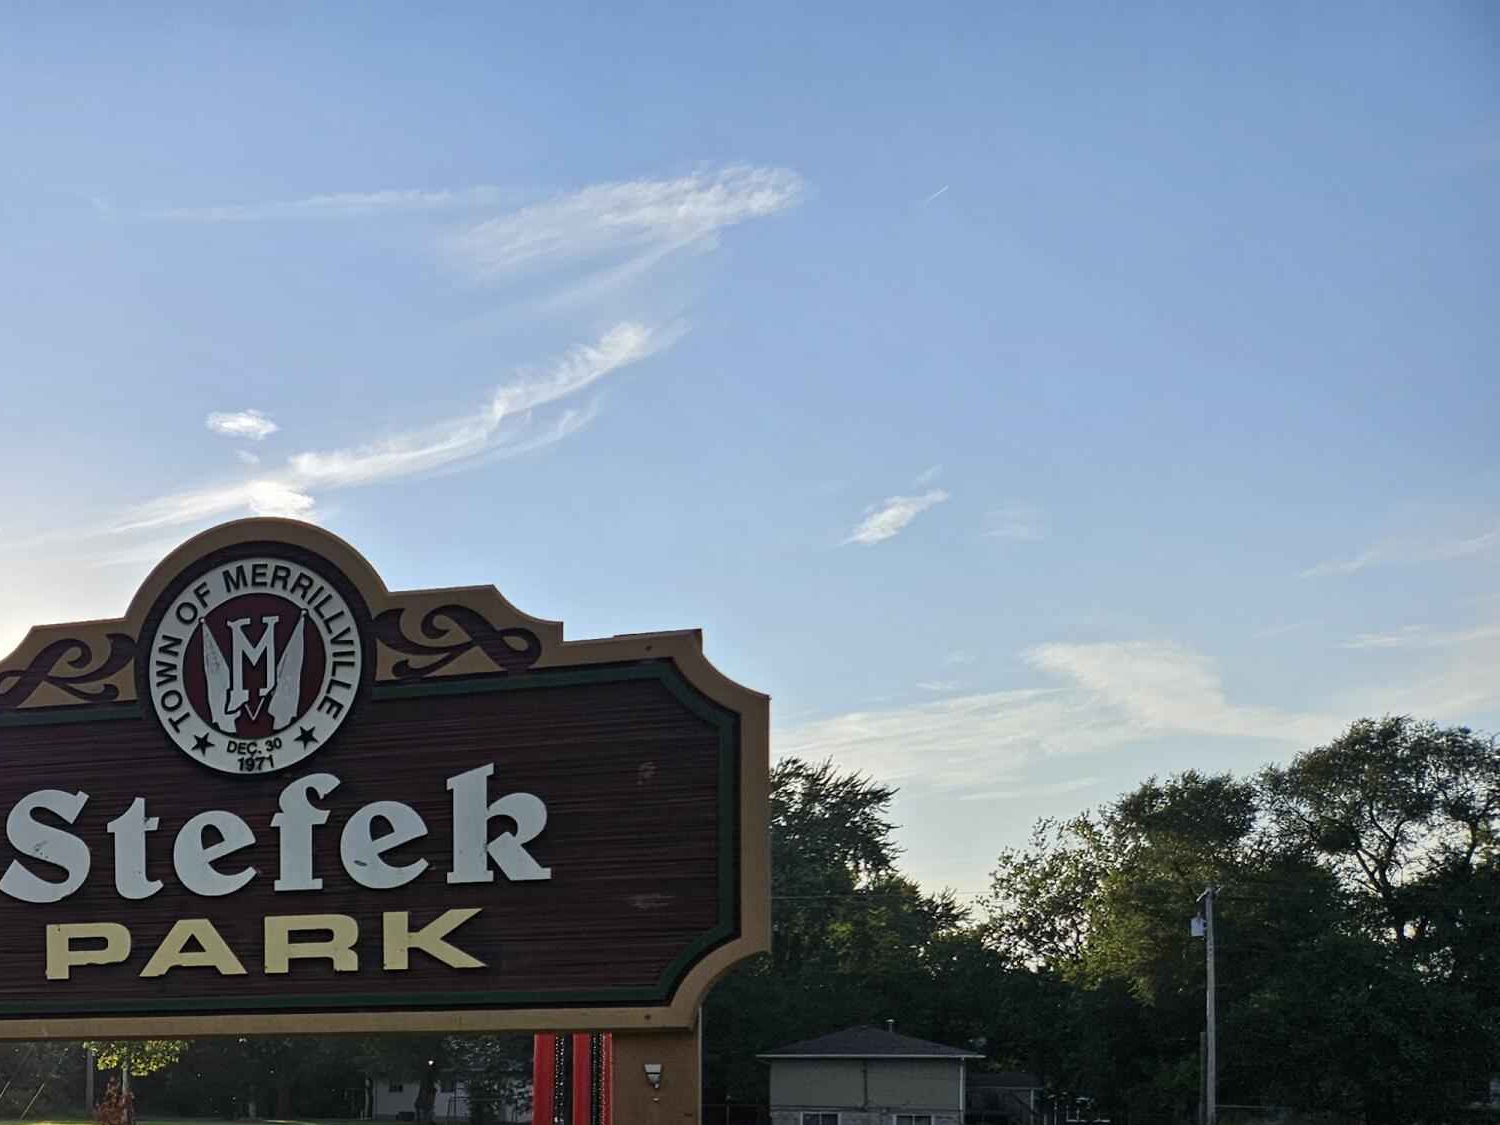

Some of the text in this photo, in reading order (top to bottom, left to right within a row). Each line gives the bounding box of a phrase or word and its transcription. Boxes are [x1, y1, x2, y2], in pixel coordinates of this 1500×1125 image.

[156, 563, 355, 733] TOWN OF MERRILLVILLE
[226, 737, 282, 755] DEC. 30
[238, 755, 274, 771] 1971
[46, 908, 489, 980] PARK
